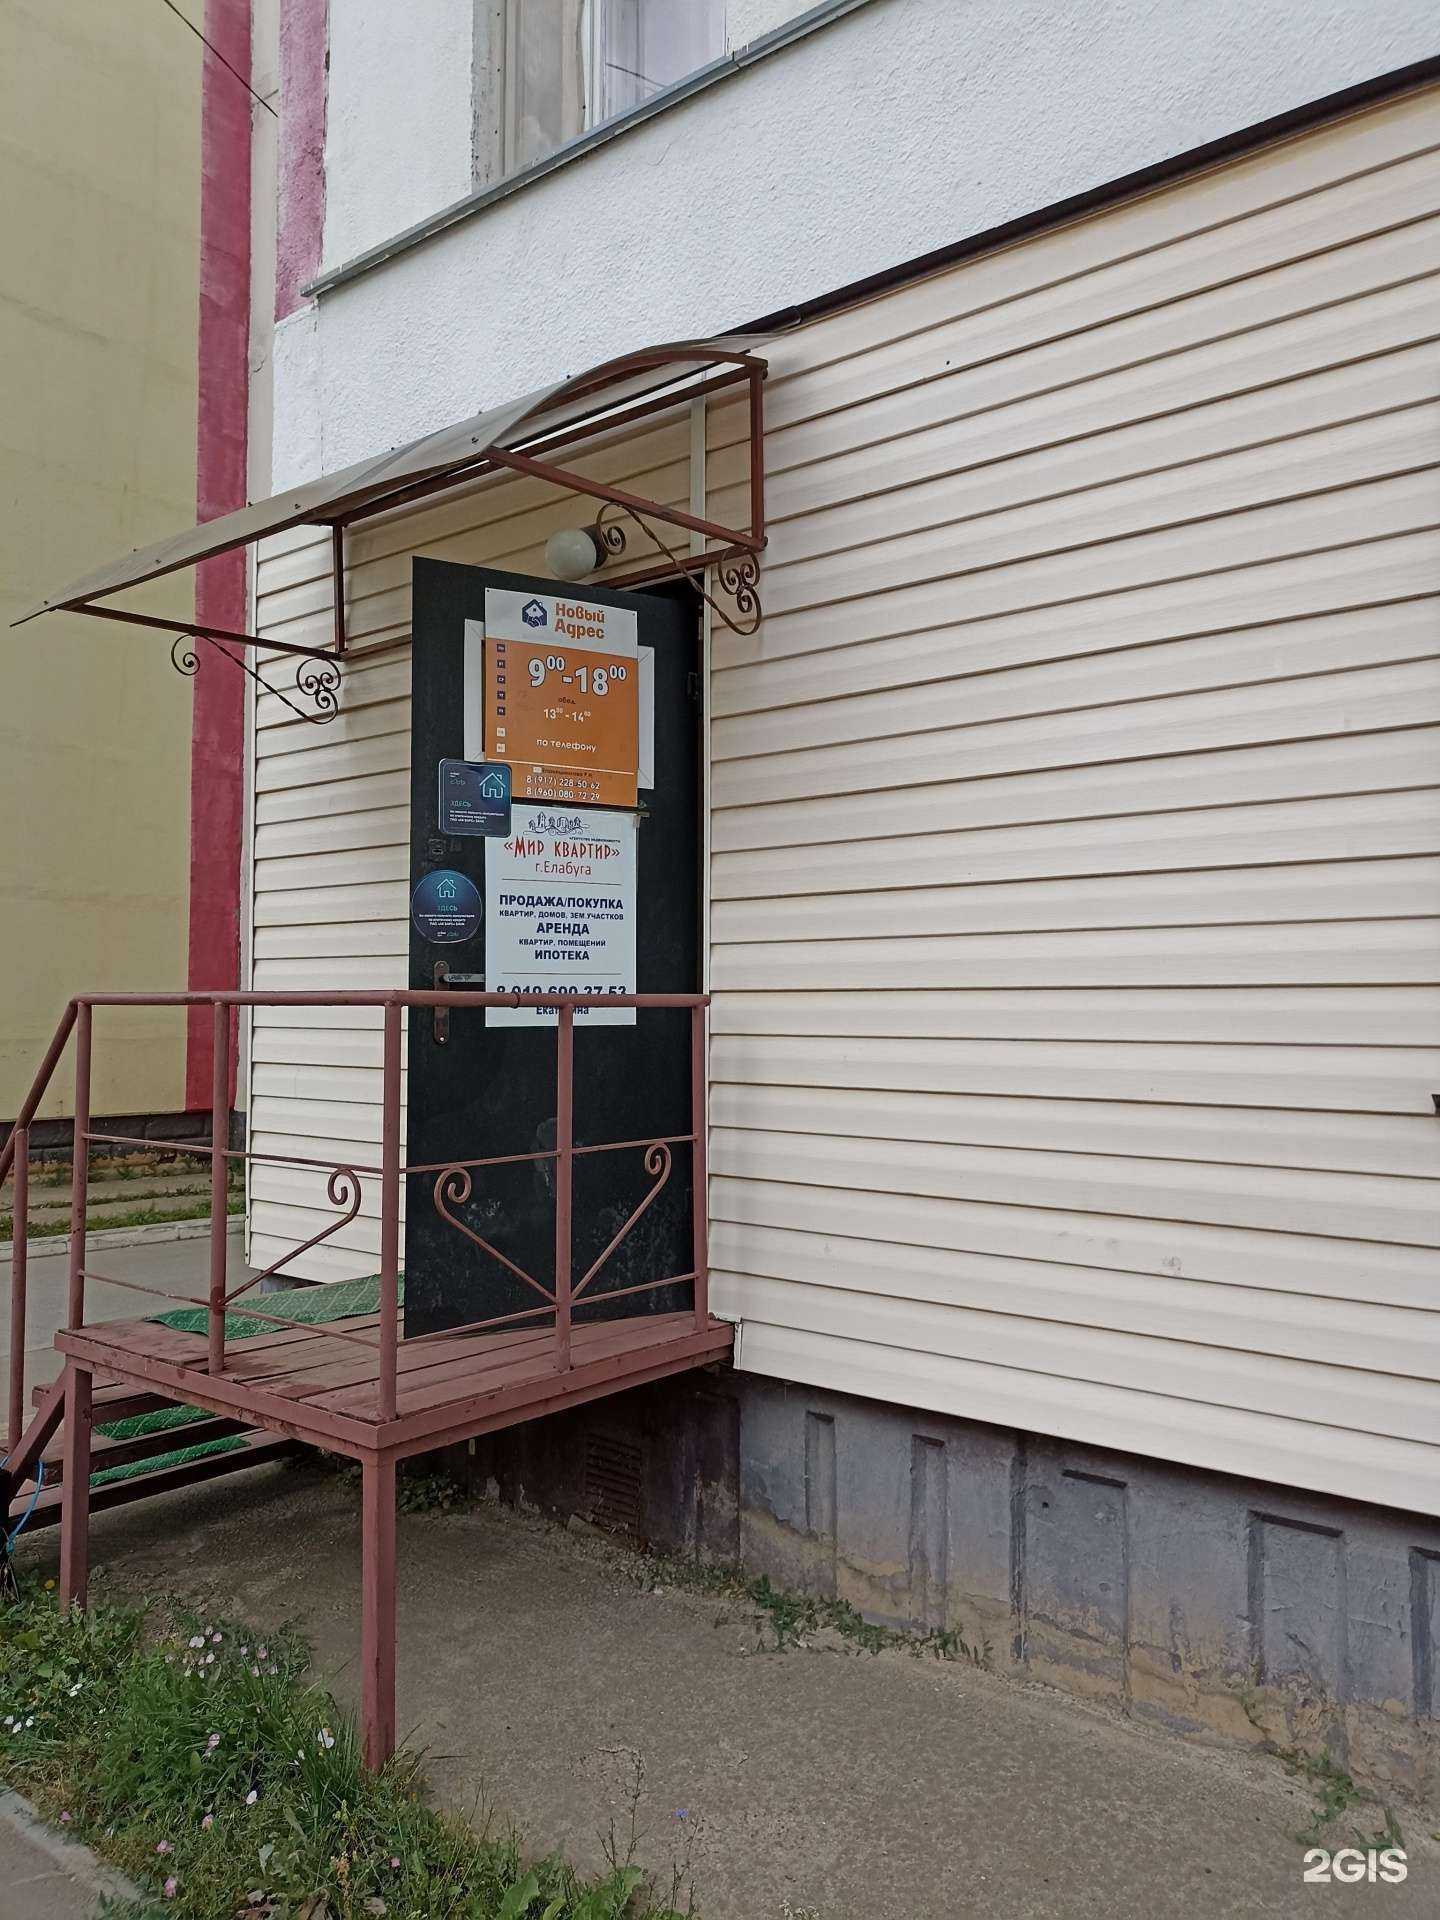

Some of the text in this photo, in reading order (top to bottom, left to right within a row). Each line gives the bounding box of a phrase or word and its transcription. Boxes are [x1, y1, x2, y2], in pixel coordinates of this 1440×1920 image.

[555, 602, 605, 624] Новый
[554, 618, 605, 639] Адрес
[536, 738, 597, 753] по телефону
[526, 775, 532, 784] 8
[526, 787, 532, 796] 8
[499, 895, 624, 909] ПРОДАЖА/ПОКУПКА
[536, 922, 590, 936] АРЕНДА
[518, 938, 606, 948] КВАРТИР, ПОМЕЩЕНИЙ
[534, 950, 590, 961] ИПОТЕКА
